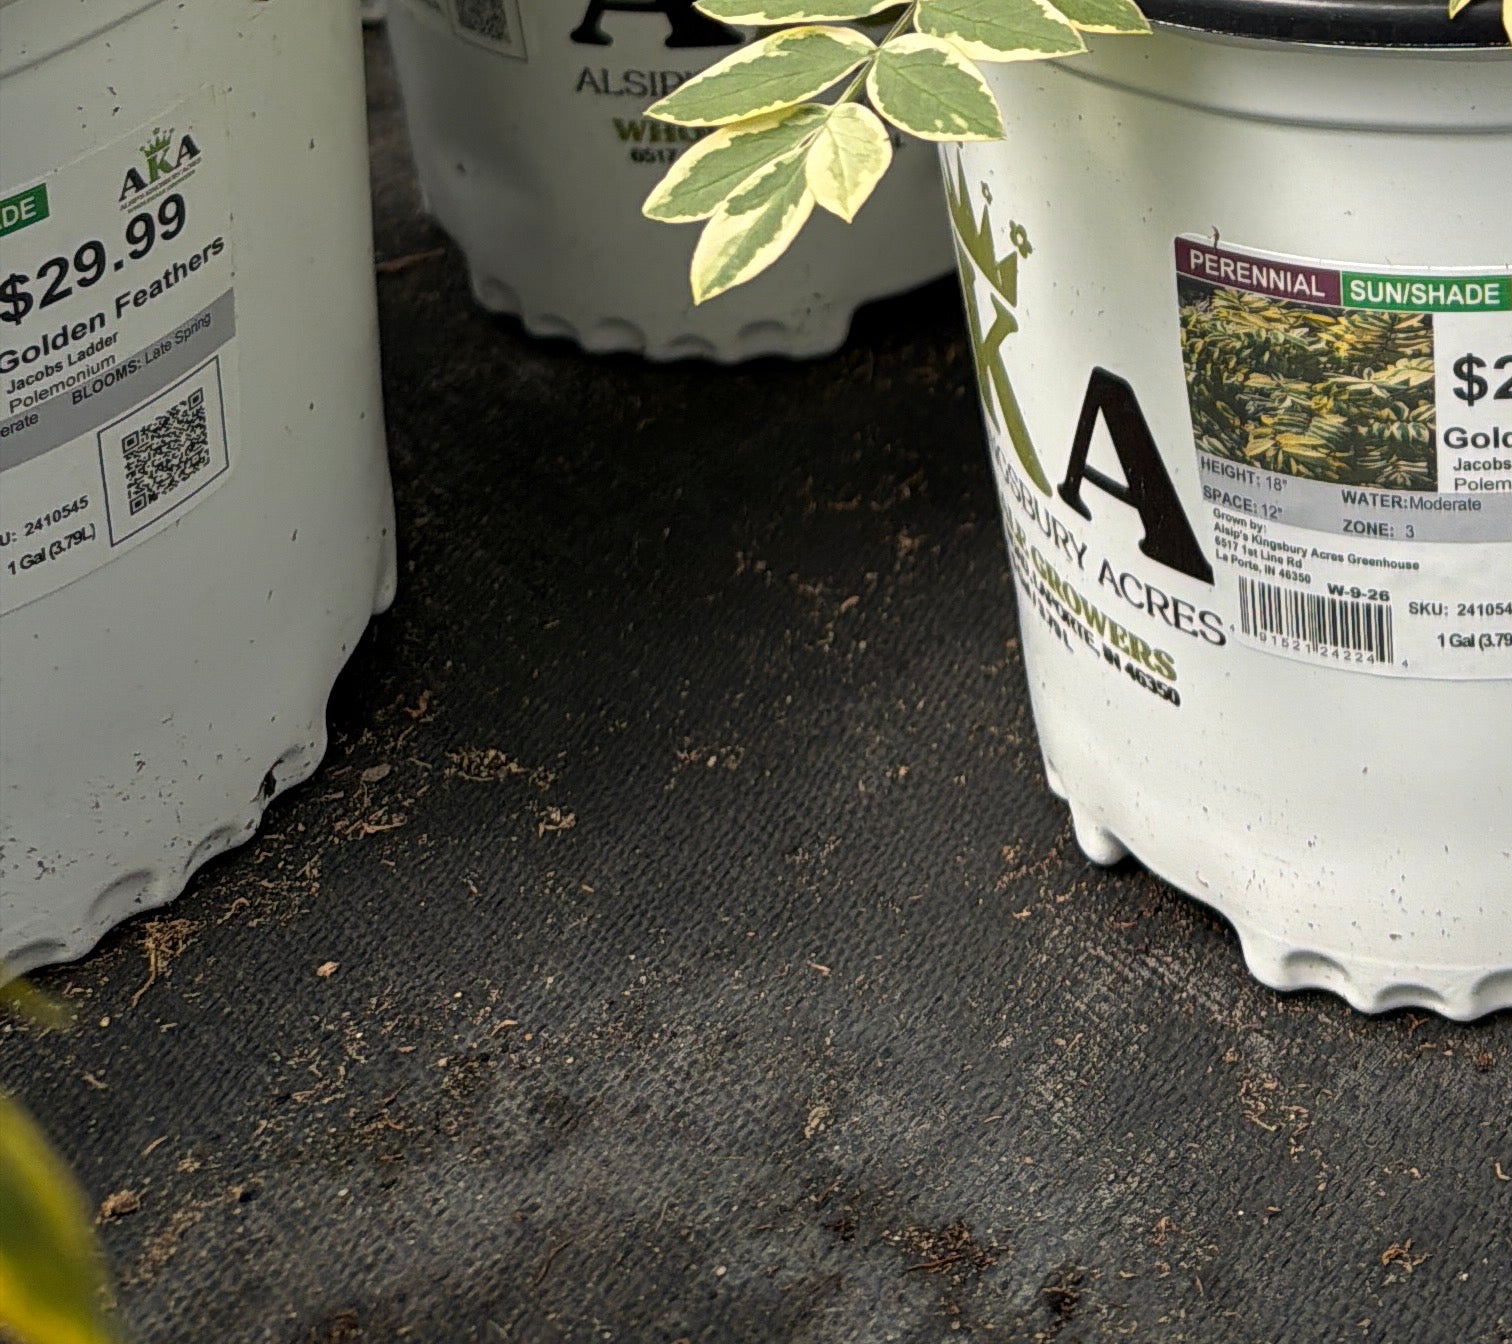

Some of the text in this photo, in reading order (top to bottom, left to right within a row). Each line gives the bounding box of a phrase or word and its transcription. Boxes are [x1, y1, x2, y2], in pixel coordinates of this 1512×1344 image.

[575, 66, 699, 97] ALSIP
[118, 134, 202, 203] AKA
[0, 195, 37, 228] DE
[0, 193, 187, 327] $29.99
[1190, 248, 1500, 305] PERENNIAL SUN/SHADE
[0, 236, 225, 374] Golden Feathers
[0, 312, 212, 438] erate BLOOMS: Late Spring
[6, 331, 119, 395] Jacobs Ladder
[9, 354, 116, 414] Polemonium
[1201, 455, 1288, 492] HEIGHT: 18"
[1453, 456, 1512, 472] Jacobs
[24, 495, 89, 537] 2410545
[1203, 484, 1283, 520] SPACE: 12"
[1213, 508, 1267, 535] Grown by:
[8, 523, 96, 575] 1 Gal (3.79L)
[988, 430, 1088, 571] GSBURY
[1098, 558, 1227, 647] ACRES
[1214, 522, 1420, 571] Alsip's Kingsbury Acres Greenhouse
[1342, 518, 1415, 538] ZONE: 3
[1214, 536, 1303, 569] 6517 1st Line Rd
[1216, 548, 1311, 584] La Porte, IN 46350
[1327, 582, 1391, 602] W-9-26
[1409, 601, 1449, 617] SKU:
[1030, 545, 1178, 682] GROWERS
[1437, 633, 1445, 648] 1
[1449, 632, 1475, 648] Gal
[1125, 662, 1181, 708] 46350
